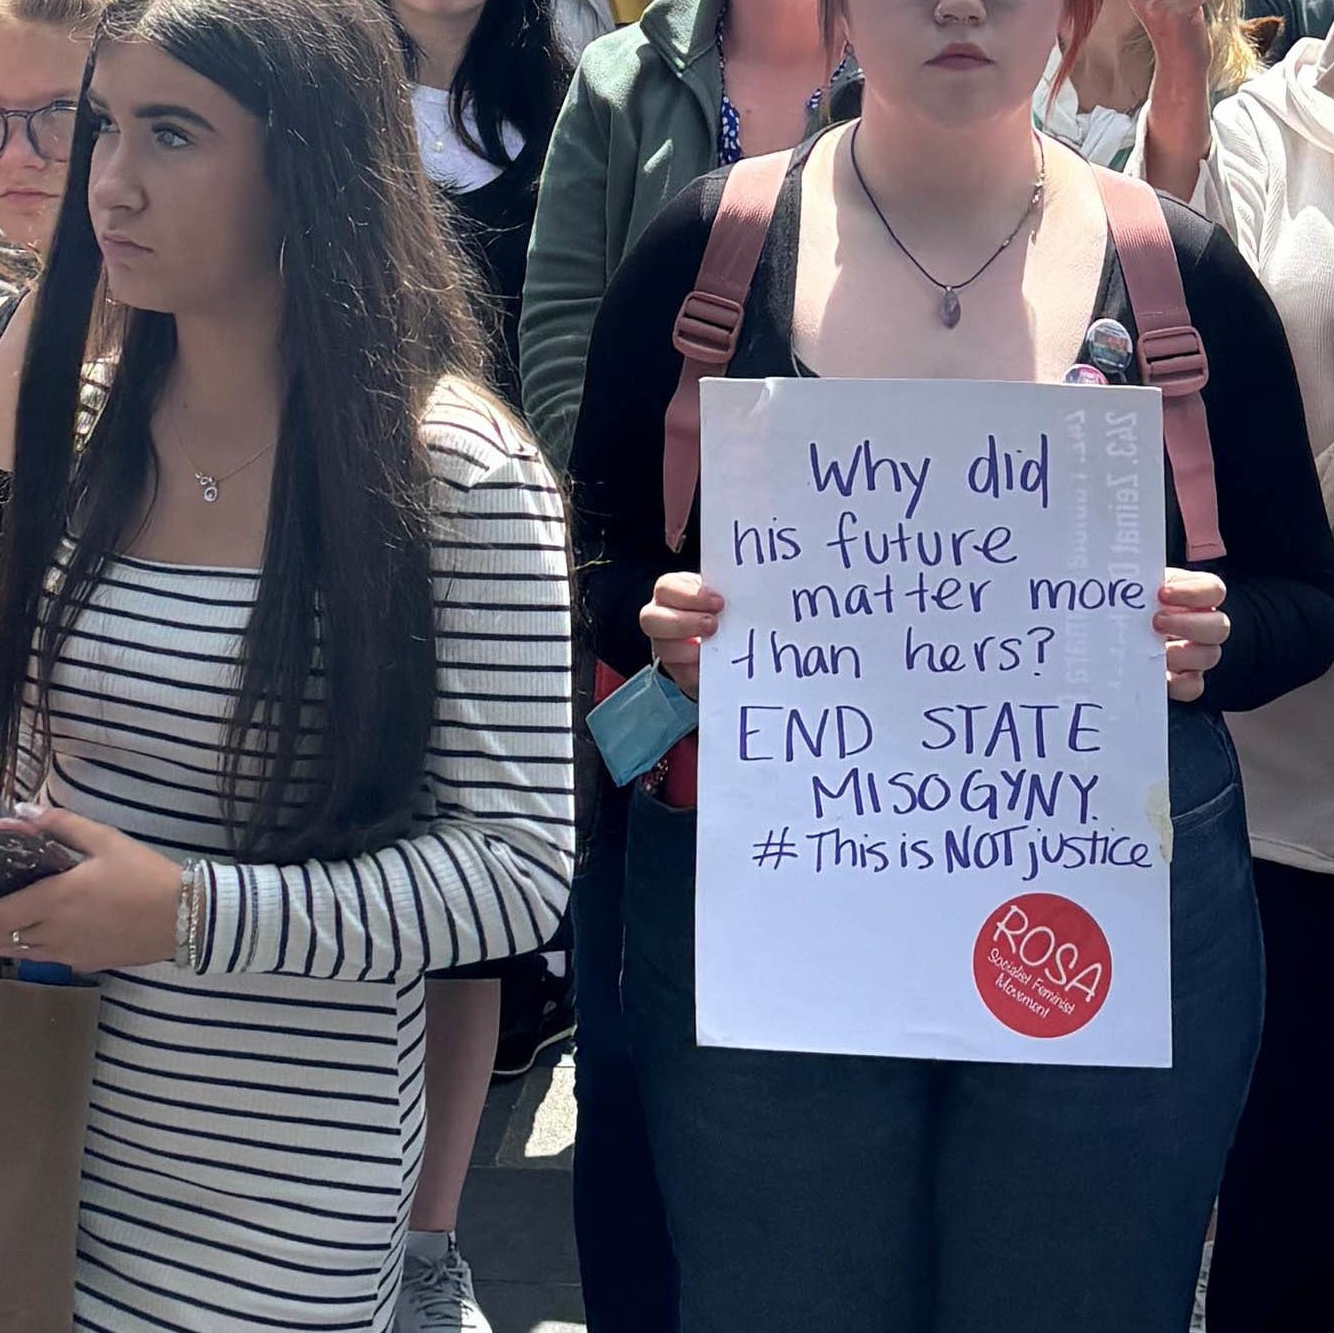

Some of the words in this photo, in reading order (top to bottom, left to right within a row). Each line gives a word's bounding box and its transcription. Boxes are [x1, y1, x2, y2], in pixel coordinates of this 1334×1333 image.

[809, 439, 931, 519] Why
[968, 434, 1049, 508] did
[734, 517, 802, 566] his
[827, 511, 1018, 568] future
[792, 572, 992, 623] matter
[1029, 577, 1146, 612] more
[731, 627, 862, 679] than
[906, 626, 1056, 677] hers?
[740, 705, 873, 762] END
[921, 702, 1104, 762] STATE
[987, 947, 1031, 986] Socialist
[1032, 977, 1076, 1015] Feminist
[993, 905, 1102, 1003] ROSA
[995, 973, 1050, 1018] Movement
